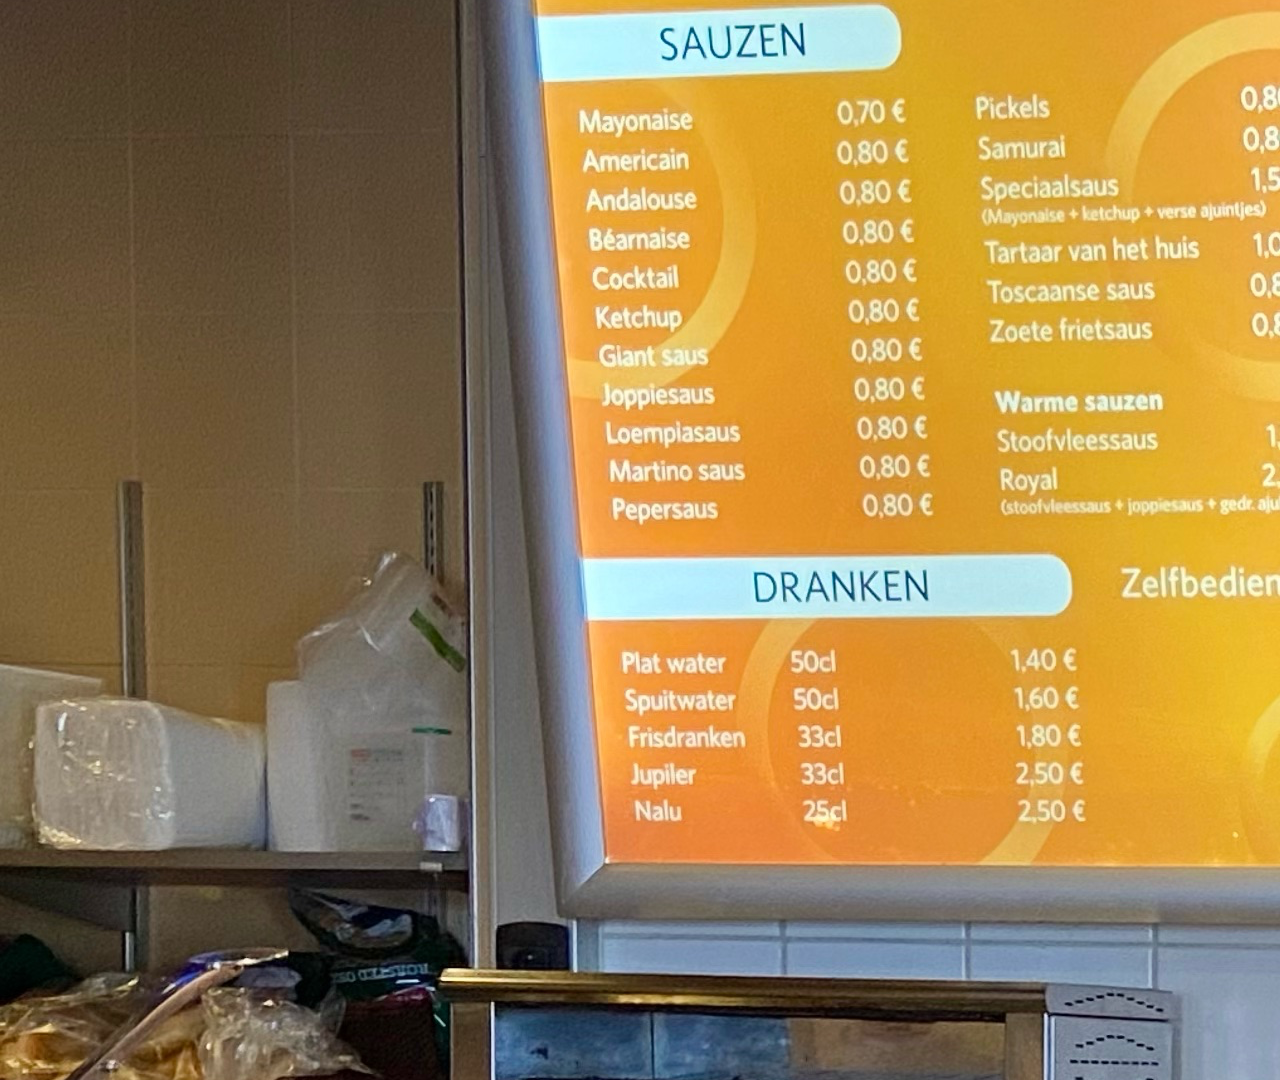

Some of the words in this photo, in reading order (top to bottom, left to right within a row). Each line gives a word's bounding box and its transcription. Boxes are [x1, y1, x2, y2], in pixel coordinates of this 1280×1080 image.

[659, 22, 806, 61] SAUZEN
[579, 109, 693, 135] Mayonaise
[837, 100, 885, 124] 0,70
[976, 94, 1050, 119] Pickels
[979, 136, 1065, 160] Samurai
[583, 149, 689, 172] Americain
[586, 188, 696, 211] Andalouse
[981, 175, 1118, 202] Speciaalsaus
[589, 228, 690, 251] Béarnaise
[984, 240, 1062, 263] Tartaar
[1068, 244, 1106, 261] van
[1113, 237, 1148, 260] het
[1155, 236, 1199, 258] huis
[592, 265, 678, 290] Cocktail
[986, 280, 1100, 303] Toscaanse
[1107, 282, 1155, 300] saus
[595, 306, 681, 330] Ketchup
[990, 320, 1053, 342] Zoete
[1059, 318, 1152, 341] frietsaus
[599, 345, 654, 367] Giant
[662, 348, 708, 365] saus
[603, 384, 715, 409] Joppiesaus
[994, 390, 1078, 413] Warme
[1084, 393, 1163, 411] sauzen
[606, 422, 740, 446] Loempiasaus
[997, 429, 1158, 452] Stoofvleessaus
[610, 460, 693, 482] Martino
[698, 464, 745, 481] saus
[1000, 468, 1057, 495] Royal
[612, 498, 718, 524] Pepersaus
[753, 569, 930, 604] DRANKEN
[622, 651, 661, 673] Plat
[666, 653, 726, 673] water
[792, 650, 836, 672] 50cl
[1011, 649, 1056, 671] 1,40
[625, 689, 735, 715] Spuitwater
[794, 688, 838, 710] 50cl
[629, 726, 745, 747] Frisdranken
[799, 725, 841, 747] 33cl
[632, 764, 696, 788] Jupiler
[801, 763, 844, 784] 33cl
[635, 800, 681, 821] Nalu
[804, 800, 846, 822] 25cl
